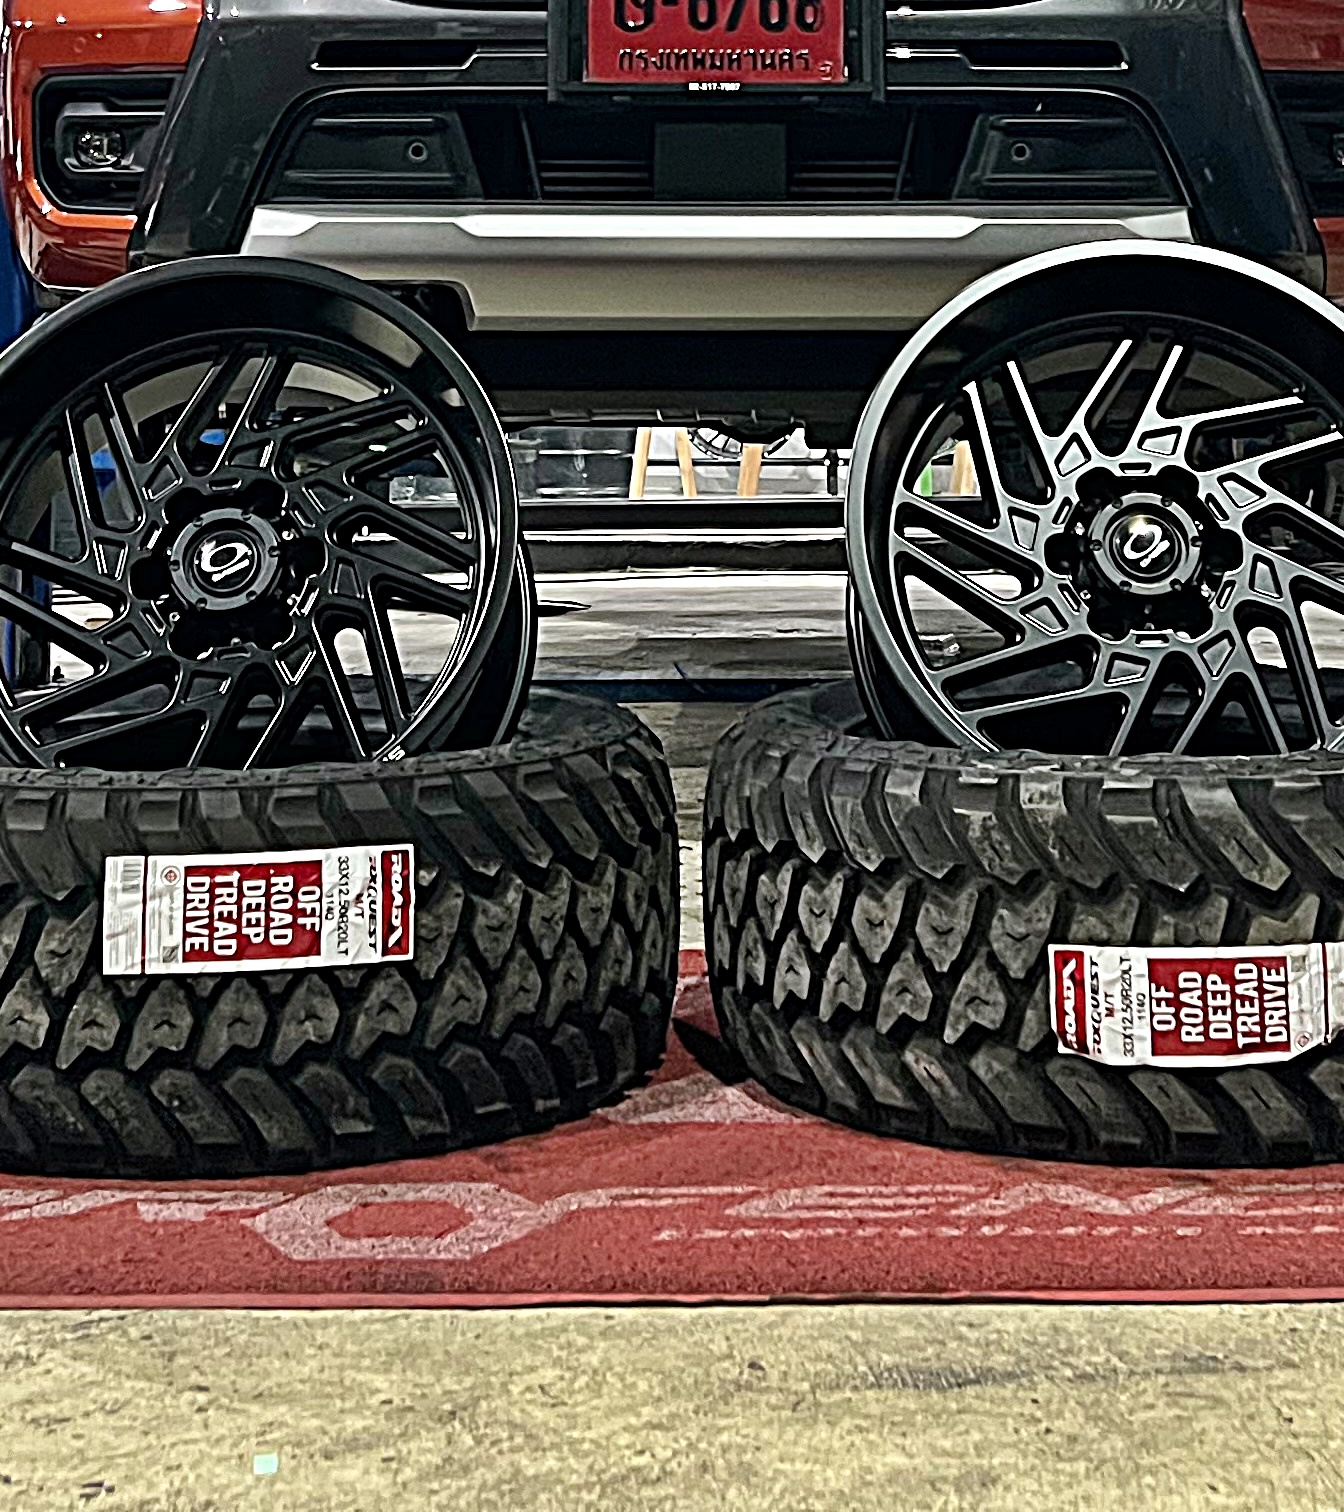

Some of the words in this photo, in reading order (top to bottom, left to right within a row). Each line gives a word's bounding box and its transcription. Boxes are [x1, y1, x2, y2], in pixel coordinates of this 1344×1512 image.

[183, 875, 211, 953] DRIVE
[212, 869, 241, 957] TREAD
[240, 878, 267, 944] DEEP
[268, 874, 294, 947] ROAD
[296, 884, 321, 933] OFF
[1150, 982, 1176, 1032] OFF
[1177, 970, 1206, 1044] ROAD
[1205, 972, 1234, 1040] DEEP
[1233, 961, 1261, 1050] TREAD
[1261, 965, 1289, 1044] DRIVE
